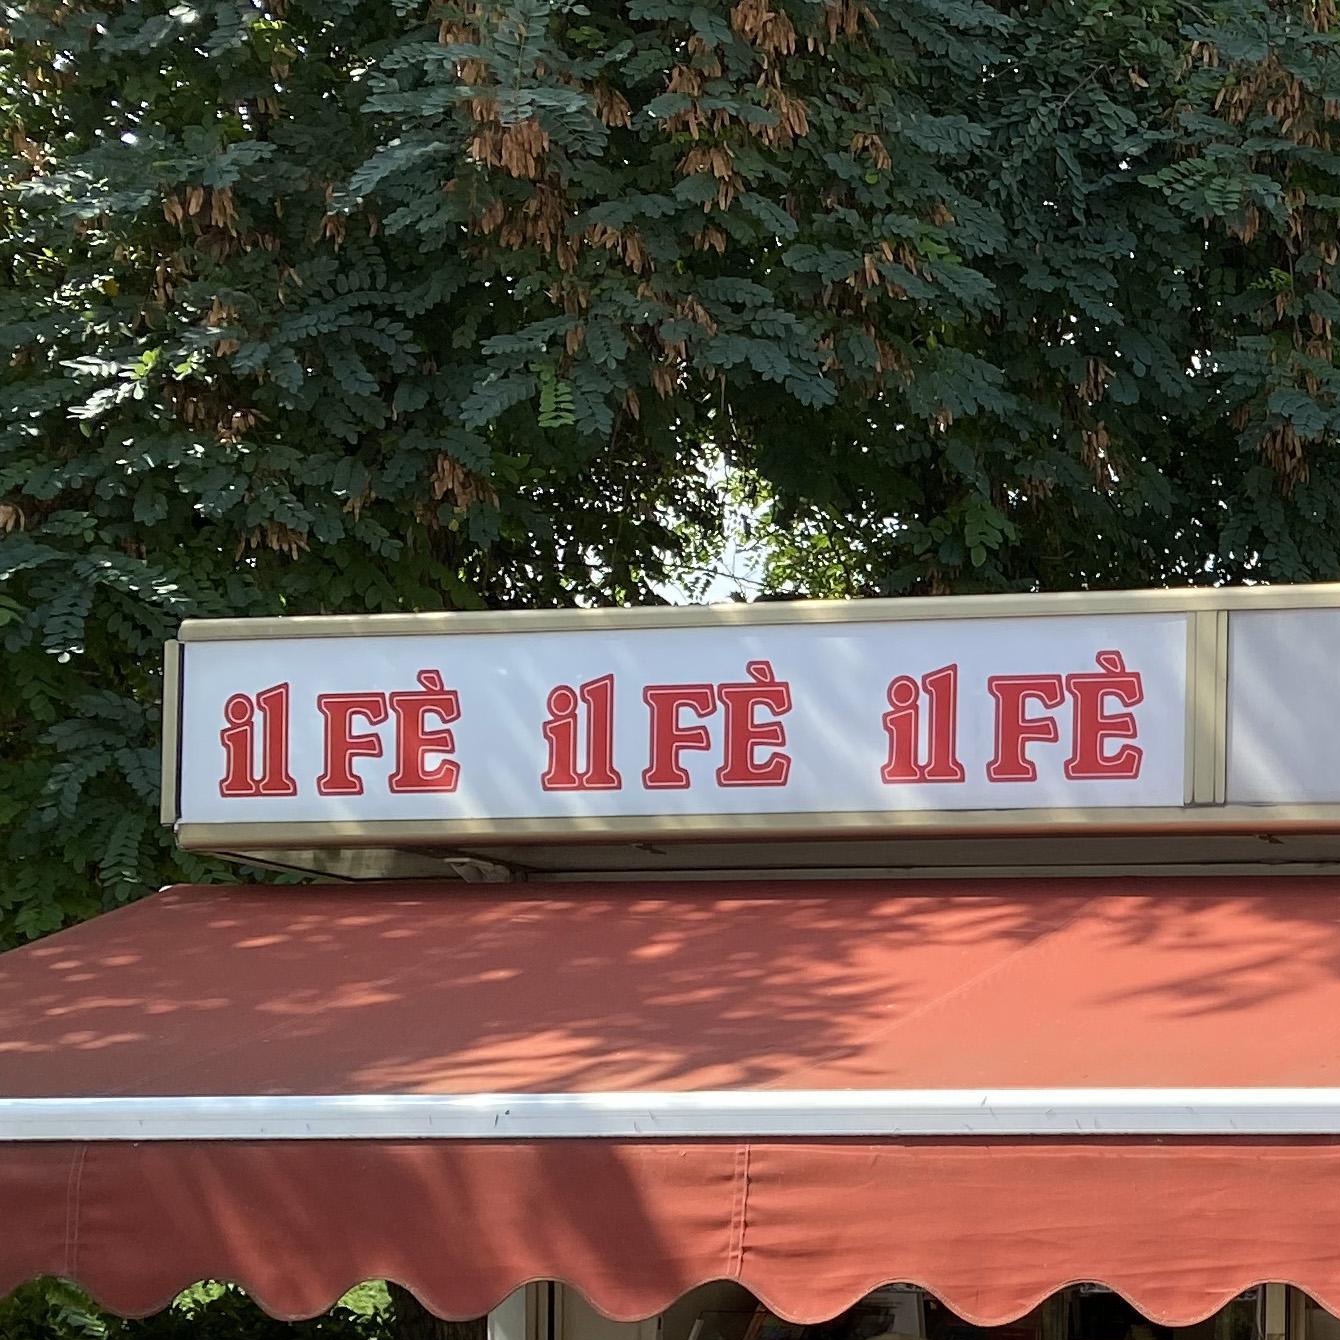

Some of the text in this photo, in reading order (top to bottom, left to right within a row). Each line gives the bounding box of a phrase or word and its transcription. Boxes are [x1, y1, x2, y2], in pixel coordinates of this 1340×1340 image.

[219, 669, 462, 797] il FÈ
[540, 660, 792, 792] il FÈ
[879, 649, 1145, 786] il FÈ
